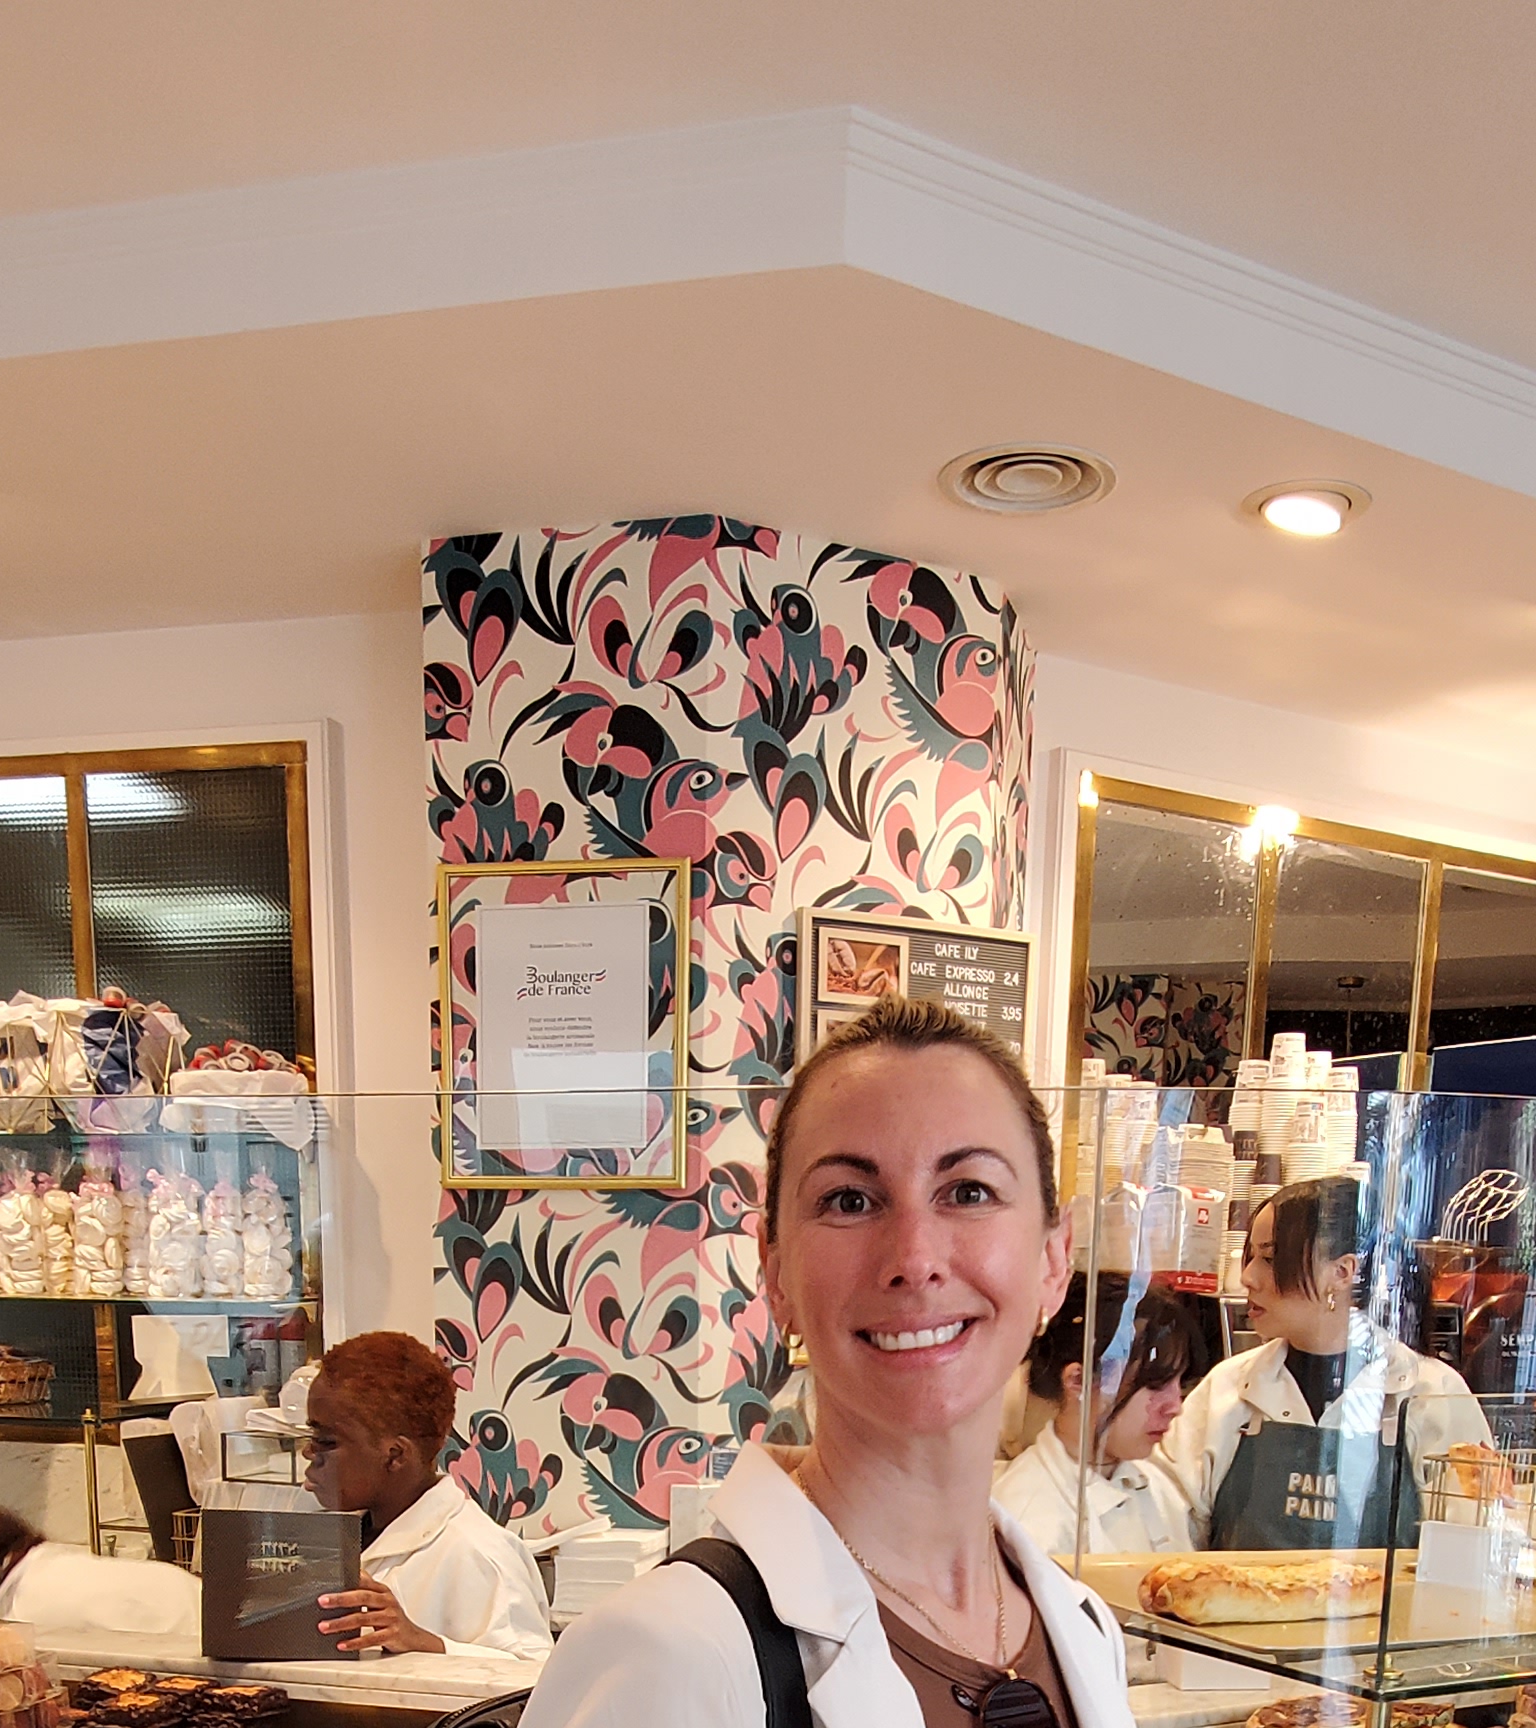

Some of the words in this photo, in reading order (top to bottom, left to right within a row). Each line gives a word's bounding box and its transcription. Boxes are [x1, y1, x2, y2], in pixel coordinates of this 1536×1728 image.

[935, 943, 961, 958] CAFE
[965, 946, 979, 960] ILY
[526, 966, 596, 985] Boulanger
[910, 962, 936, 976] CAFE
[945, 965, 995, 983] EXPRESSO
[528, 984, 544, 996] de
[548, 985, 591, 996] France
[944, 982, 989, 1000] ALLONGE
[1288, 1472, 1337, 1498] PAIN
[1285, 1496, 1337, 1521] PAIN
